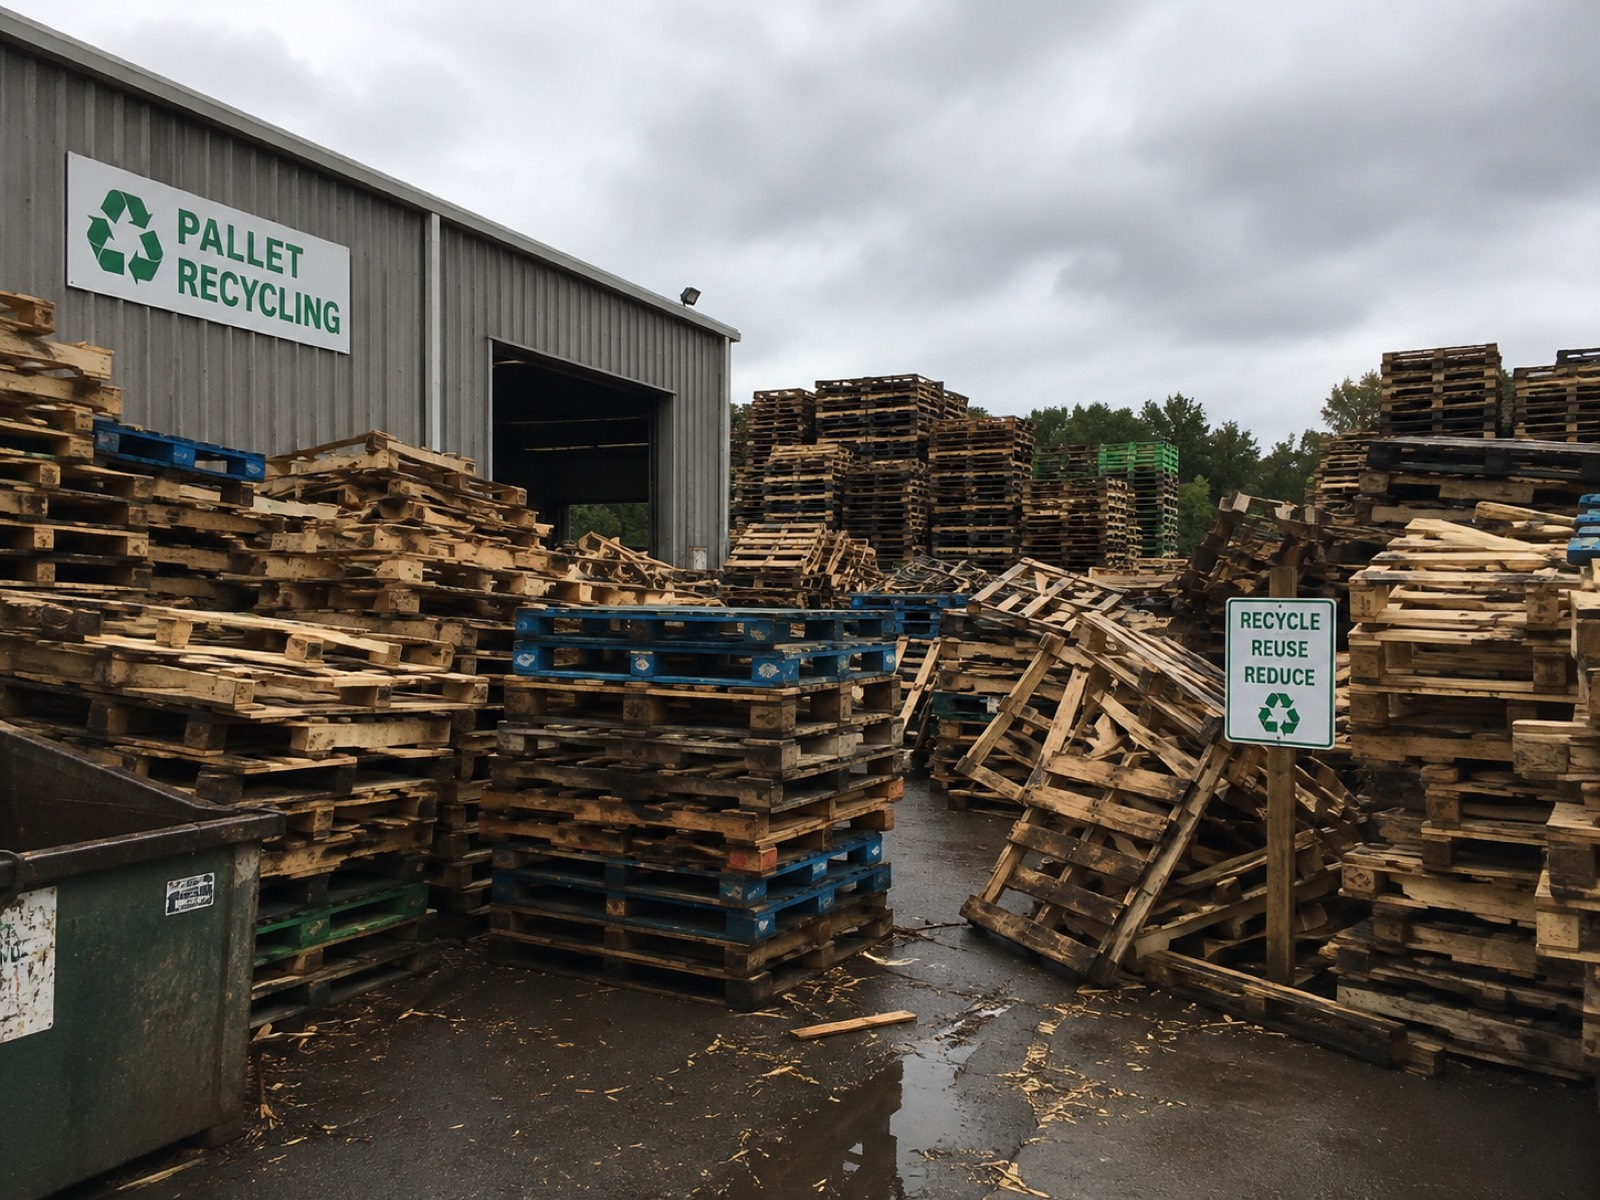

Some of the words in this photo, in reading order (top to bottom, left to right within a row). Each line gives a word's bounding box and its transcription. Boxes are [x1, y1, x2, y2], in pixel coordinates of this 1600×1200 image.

[178, 208, 303, 278] PALLET
[178, 257, 340, 335] RECYCLING
[1240, 612, 1320, 630] RECYCLE
[1251, 639, 1308, 658] REUSE
[1244, 666, 1315, 686] REDUCE
